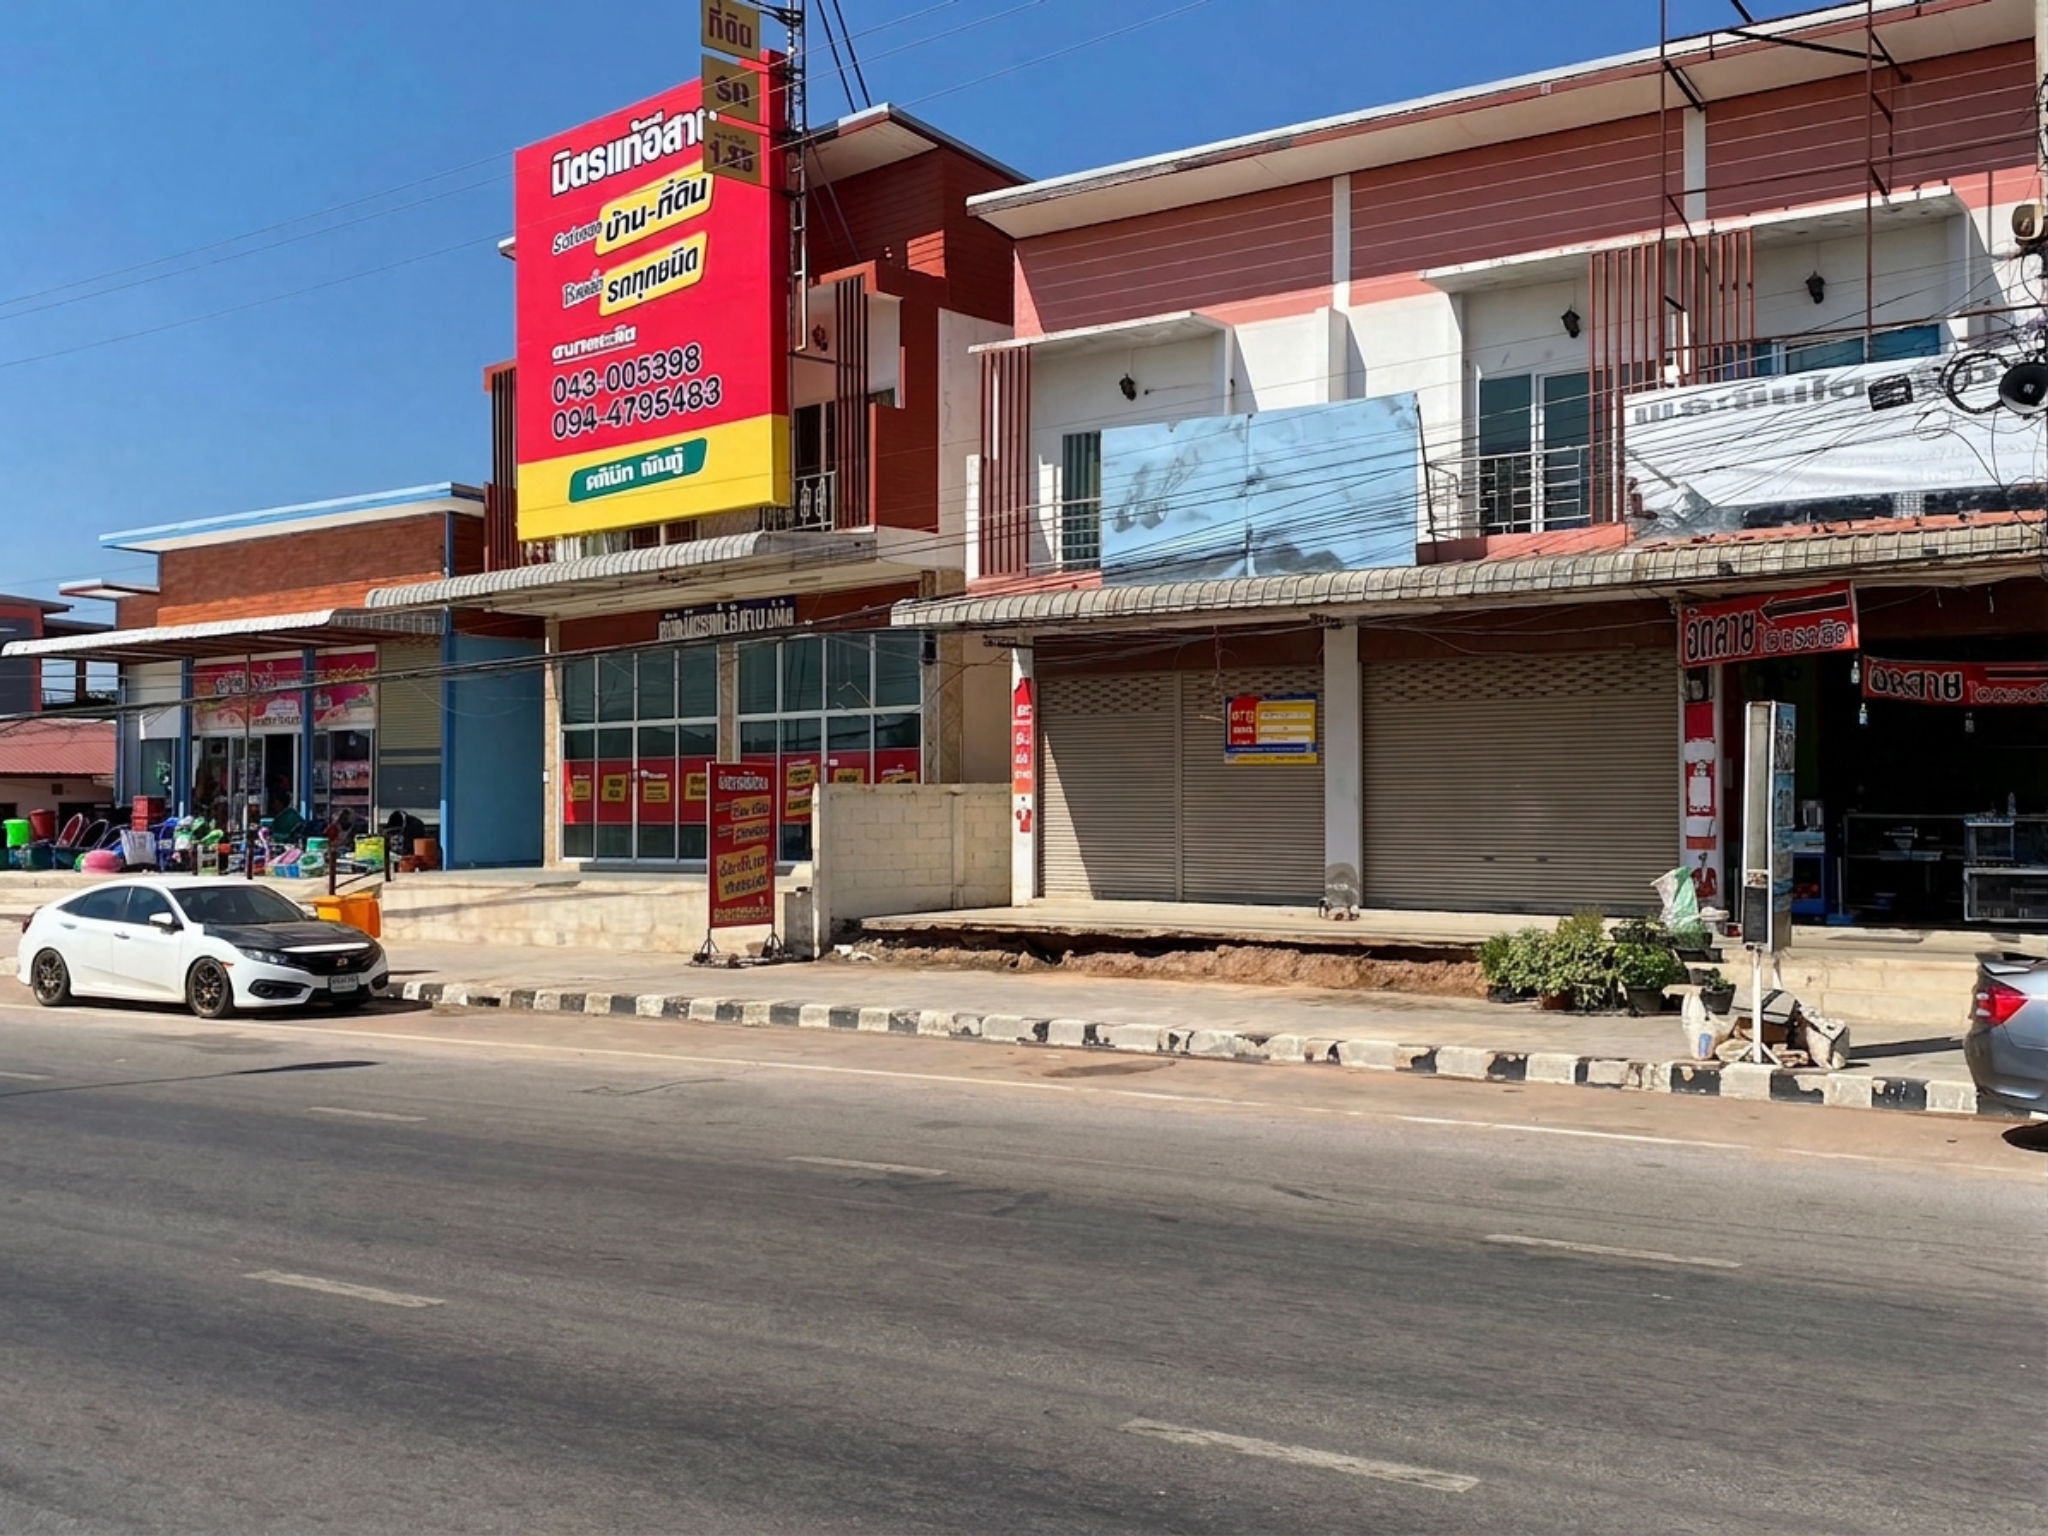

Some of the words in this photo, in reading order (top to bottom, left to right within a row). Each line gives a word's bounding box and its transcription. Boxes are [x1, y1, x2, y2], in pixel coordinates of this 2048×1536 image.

[605, 178, 708, 243] บ้าน-ที่ดิน
[553, 343, 701, 404] 043-005398
[553, 376, 722, 439] 094-4795483
